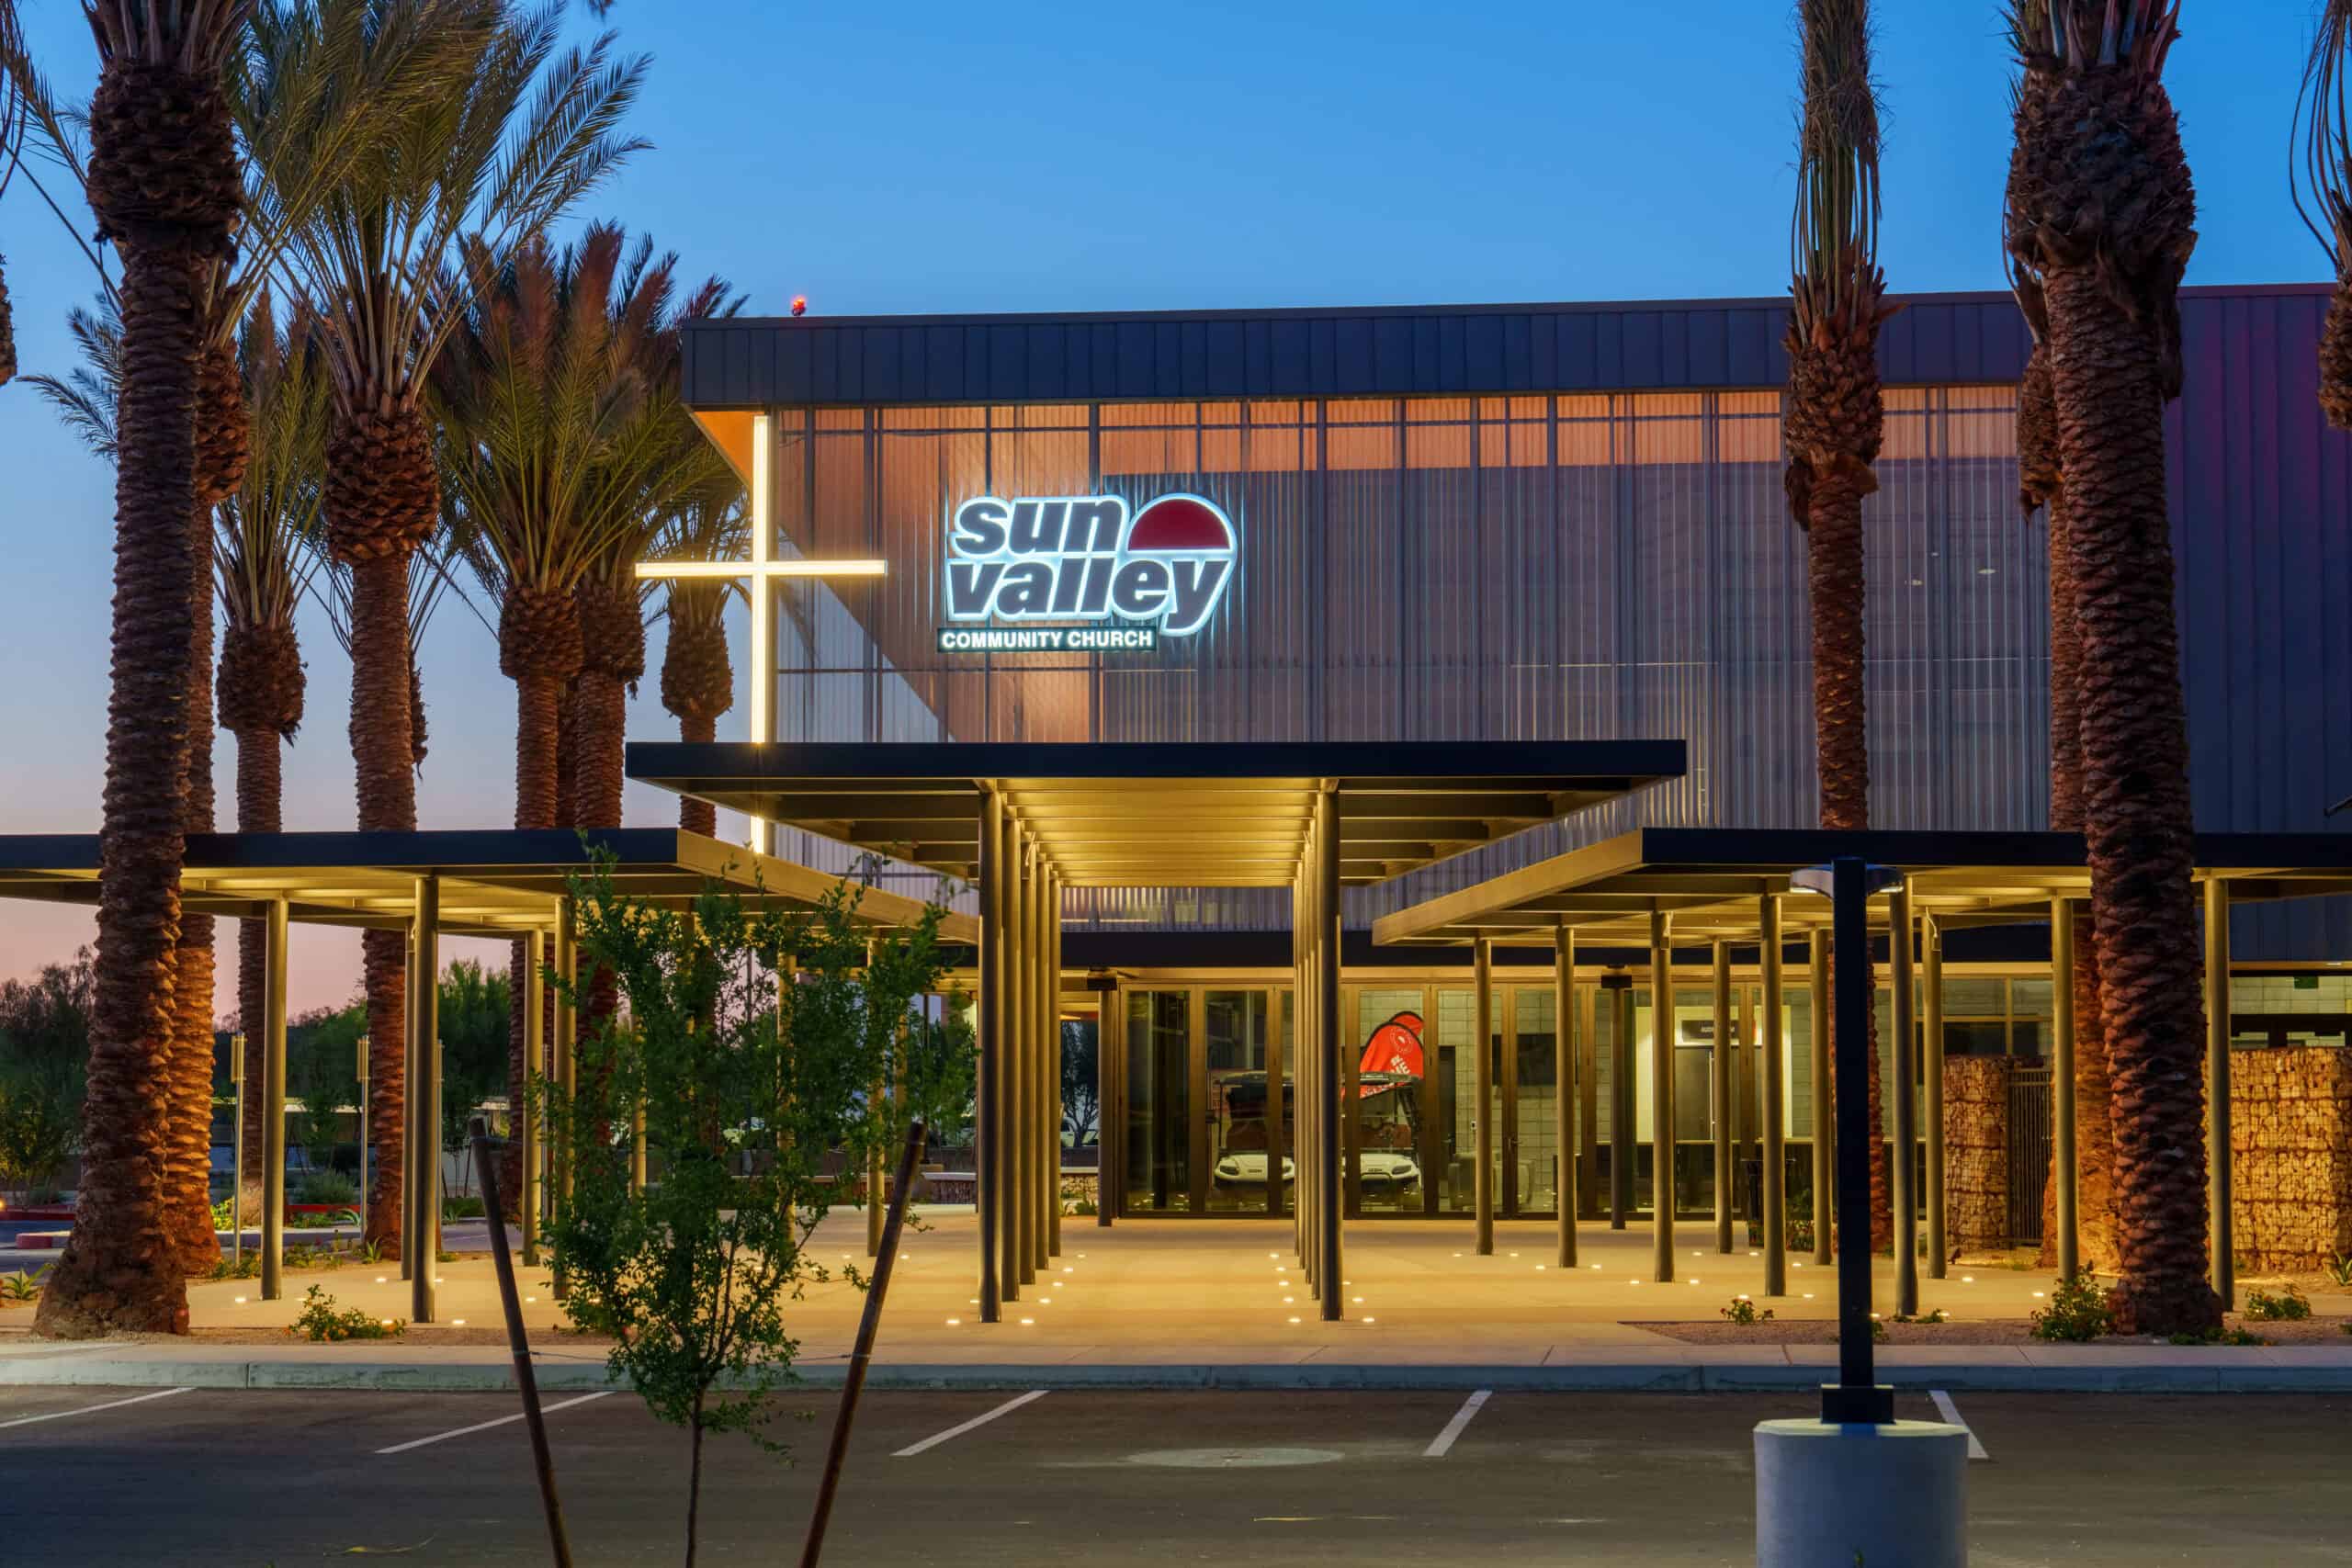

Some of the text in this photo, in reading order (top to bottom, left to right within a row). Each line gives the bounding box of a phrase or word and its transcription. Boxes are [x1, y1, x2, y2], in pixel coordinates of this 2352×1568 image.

[952, 498, 1125, 556] sun
[947, 558, 1232, 635] valley
[941, 630, 1153, 649] COMMUNITY CHURCH
